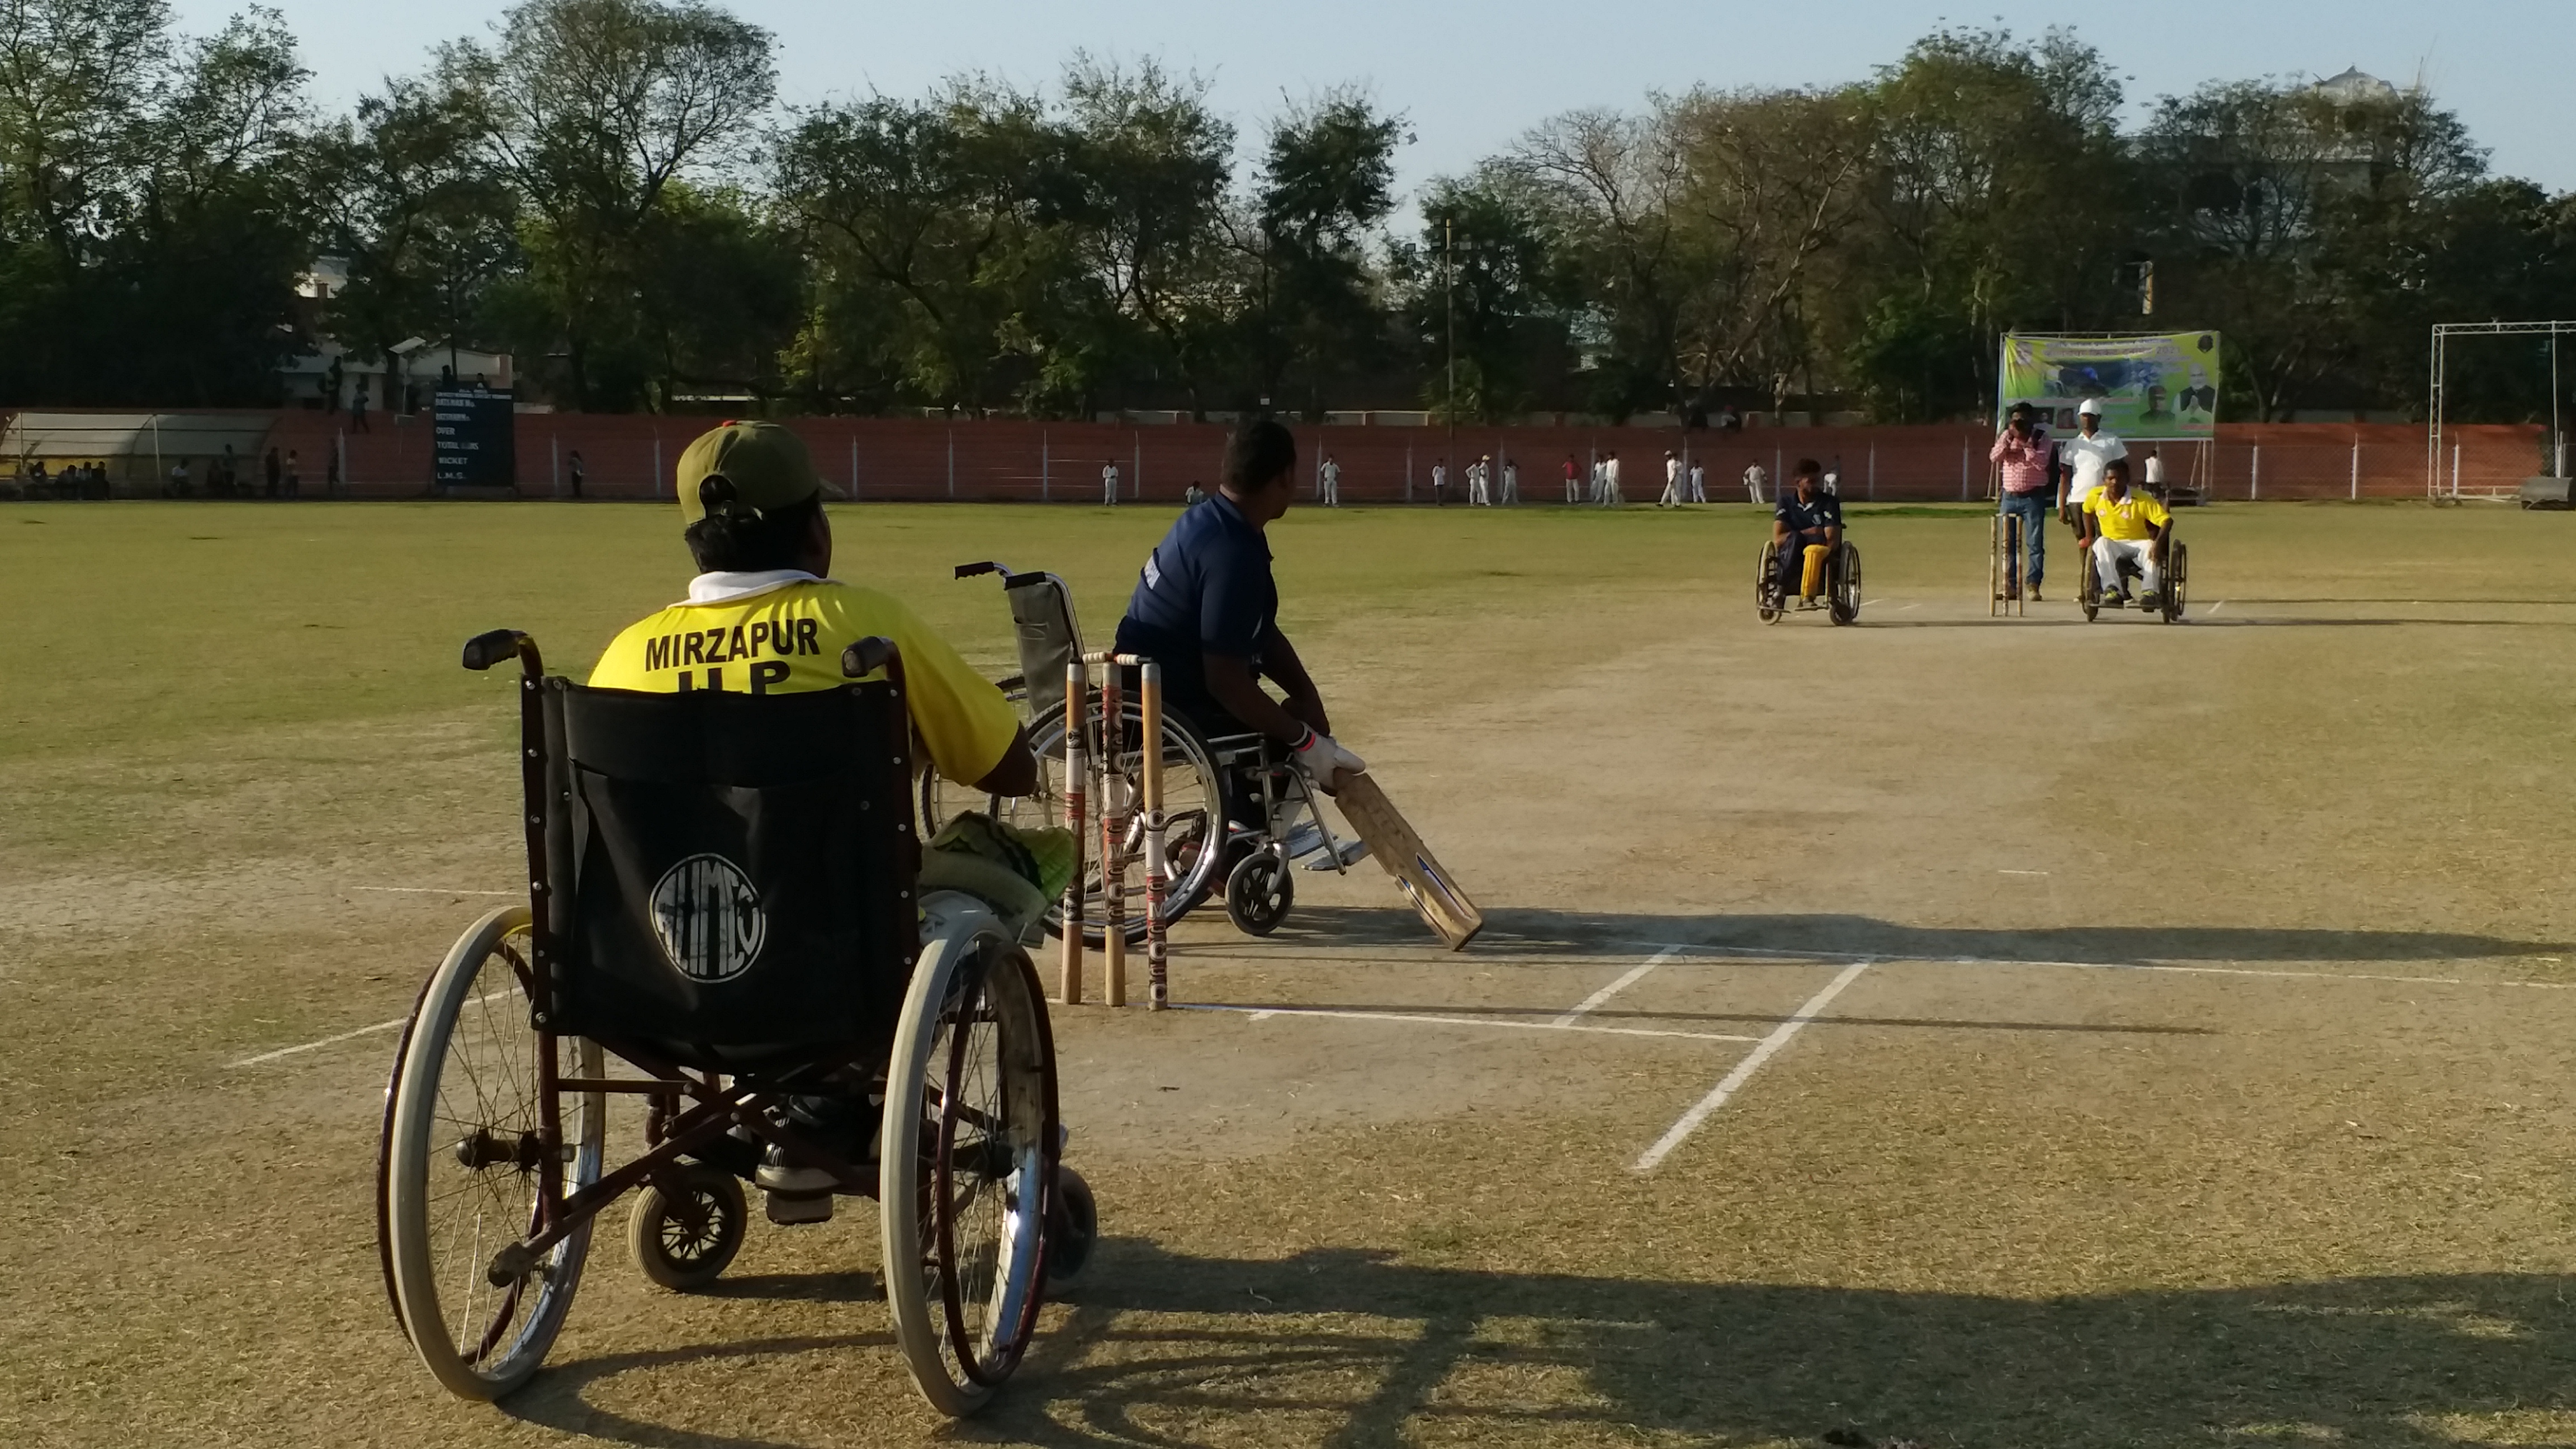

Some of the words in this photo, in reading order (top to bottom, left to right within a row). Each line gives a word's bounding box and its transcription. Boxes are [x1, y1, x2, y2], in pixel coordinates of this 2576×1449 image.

[435, 427, 455, 435] OVER
[437, 441, 460, 449] TOTAL
[646, 618, 821, 672] MIRZAPUR
